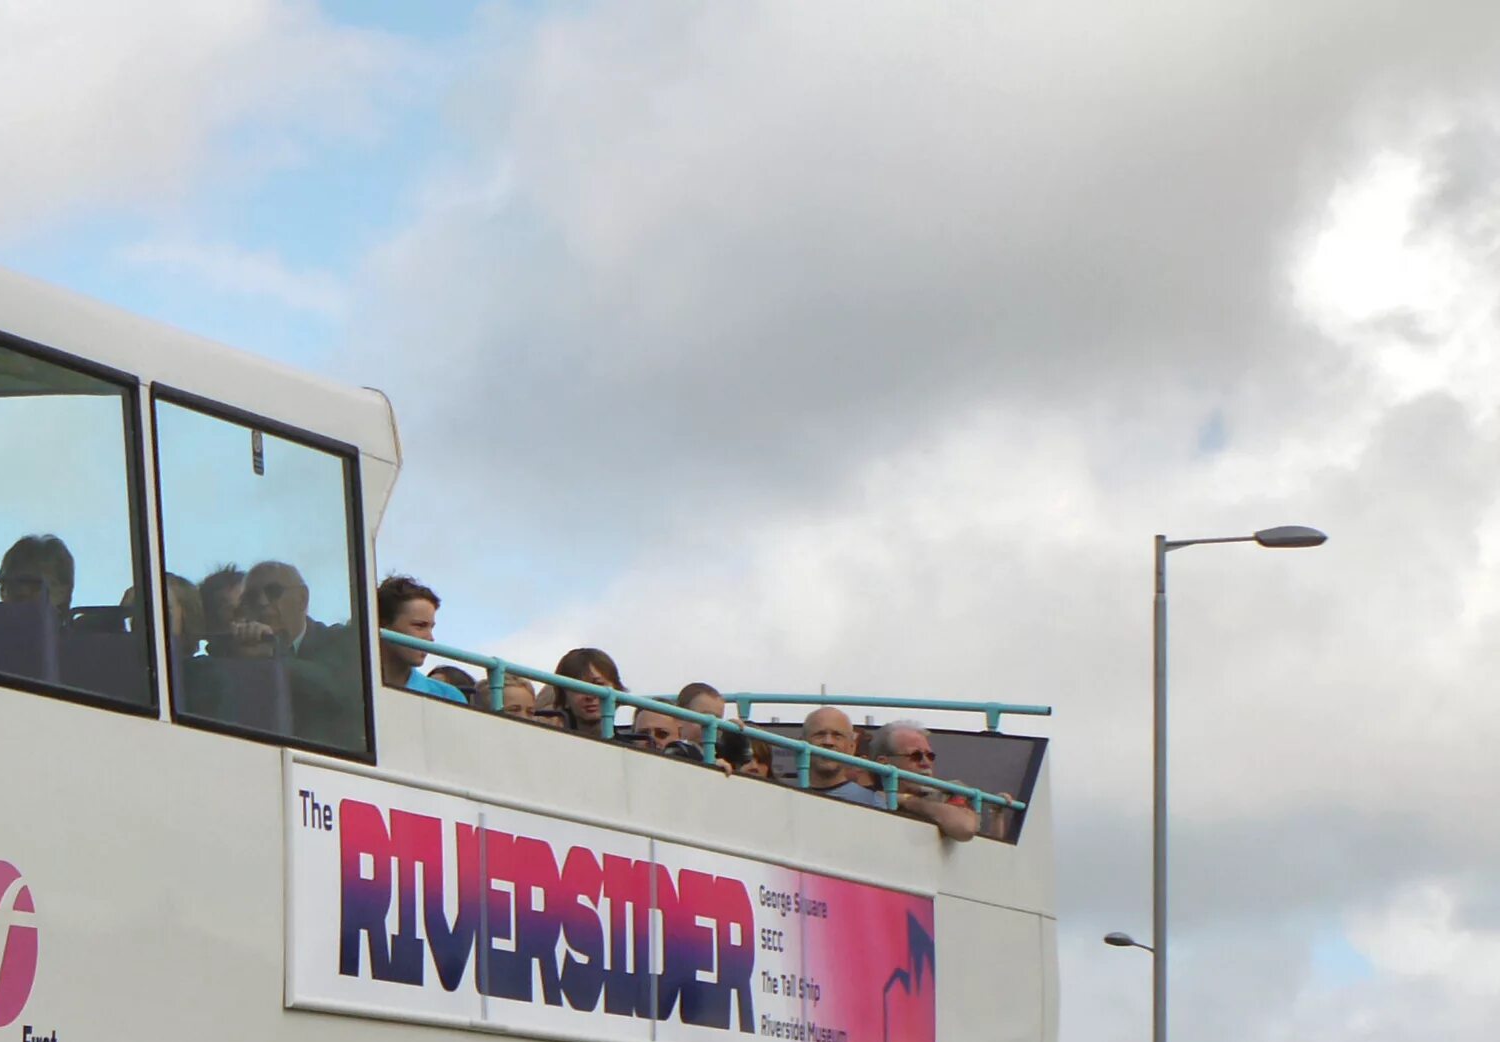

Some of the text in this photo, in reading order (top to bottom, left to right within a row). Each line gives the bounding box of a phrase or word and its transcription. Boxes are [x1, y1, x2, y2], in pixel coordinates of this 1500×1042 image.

[299, 789, 756, 1034] The RIVERSIDER
[758, 884, 792, 918] George
[760, 927, 784, 953] SECC
[760, 970, 779, 995] The
[781, 973, 797, 998] Tall
[760, 1013, 806, 1042] Riverside
